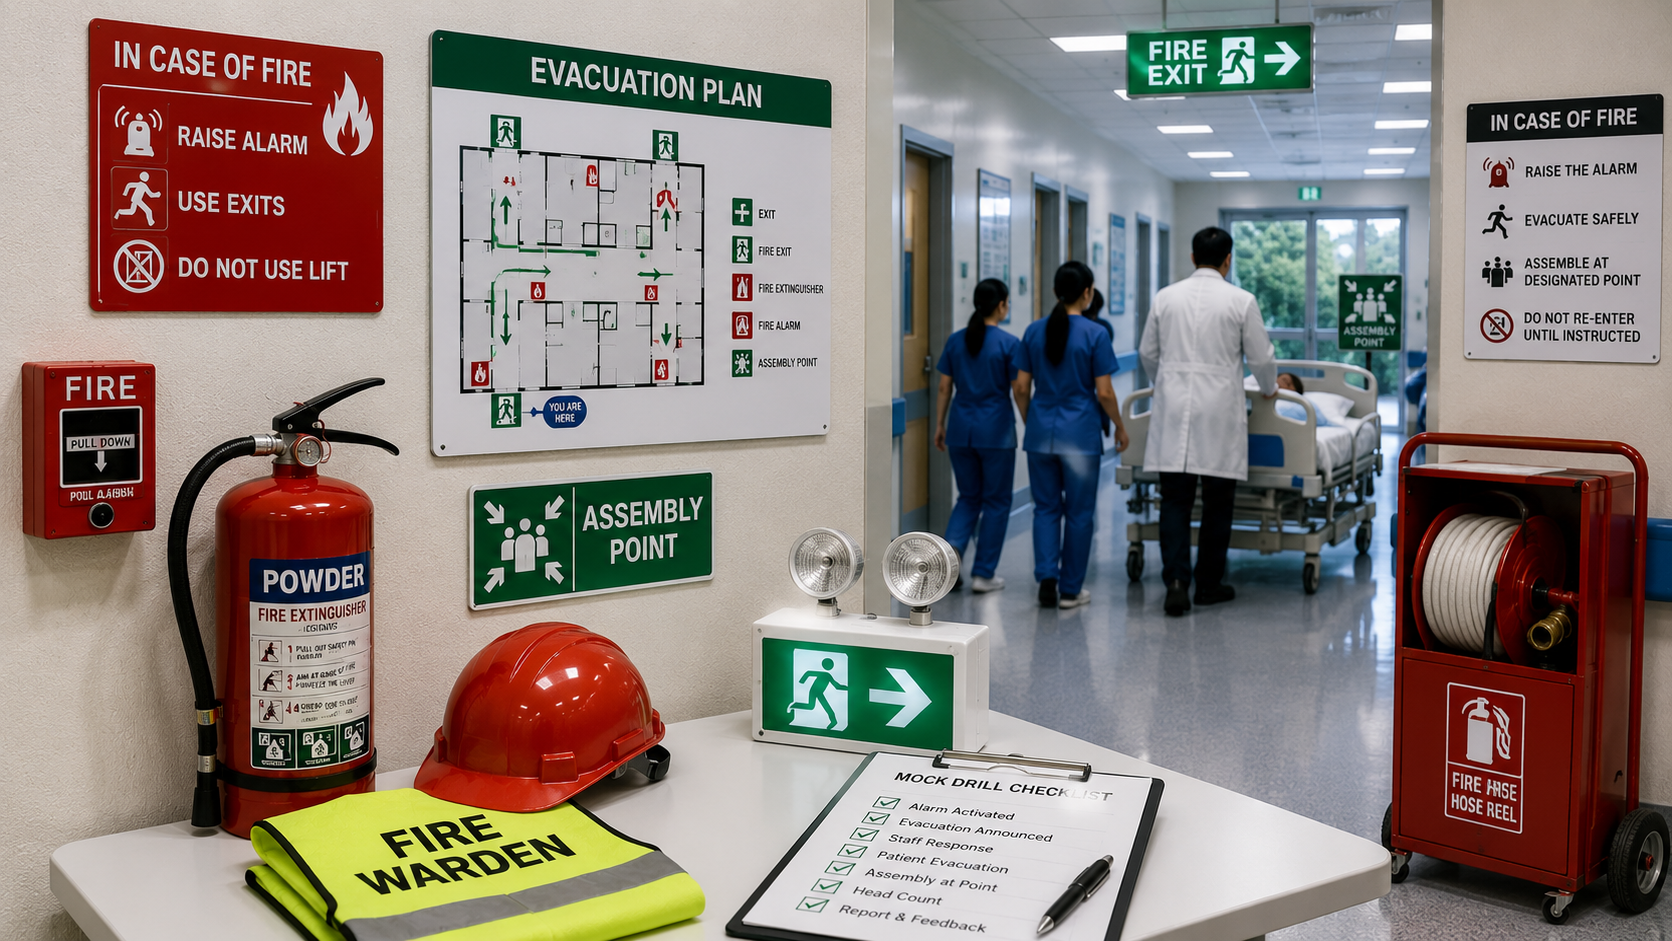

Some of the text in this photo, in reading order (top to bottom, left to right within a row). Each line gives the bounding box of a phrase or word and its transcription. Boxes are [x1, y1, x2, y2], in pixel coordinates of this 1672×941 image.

[1149, 39, 1208, 62] FIRE
[114, 41, 312, 87] IN CASE OF FIRE
[1148, 63, 1208, 86] EXIT
[531, 56, 762, 109] EVACUATION PLAN
[1490, 107, 1638, 132] IN CASE OF FIRE
[178, 125, 308, 156] RAISE ALARM
[1525, 162, 1638, 178] RAISE THE ALARM
[178, 190, 285, 216] USE EXITS
[758, 209, 776, 219] EXIT
[1525, 212, 1639, 226] EVACUATE SAFELY
[758, 246, 792, 257] FIRE EXIT
[1524, 256, 1609, 269] ASSEMBLE AT
[178, 257, 349, 281] DO NOT USE LIFT
[1524, 274, 1641, 286] DESIGNATED POINT
[758, 283, 824, 294] FIRE EXTINGUISHER
[758, 321, 801, 331] FIRE ALARM
[1524, 312, 1635, 325] DO NOT RE-ENTER
[1343, 325, 1397, 336] ASSEMBLY
[1523, 329, 1641, 342] UNTIL INSTRUCTED
[1354, 337, 1385, 348] POINT
[758, 357, 818, 368] ASSEMBLY POINT
[65, 375, 137, 401] FIRE
[549, 401, 582, 412] YOU ARE
[555, 413, 575, 423] HERE
[71, 436, 131, 449] PULL DOWN
[582, 496, 704, 532] ASSEMBLY
[610, 533, 678, 565] POINT
[263, 563, 365, 594] POWDER
[258, 600, 367, 622] FIRE EXTINGUISHER
[893, 772, 1113, 801] MOCK DRILL CHECKLIST
[1452, 771, 1482, 793] FIRE
[908, 803, 1015, 821] Alarm Activated
[1451, 793, 1517, 823] HOSE REEL
[380, 813, 503, 859] FIRE
[899, 817, 1053, 843] Evacuation Announced
[888, 834, 994, 855] Staff Response
[354, 833, 577, 895] WARDEN
[876, 850, 1009, 875] Patient Evacuation
[865, 867, 998, 893] Assembly at Point
[853, 886, 943, 906] Head Count
[839, 904, 988, 933] Report & Feedback
